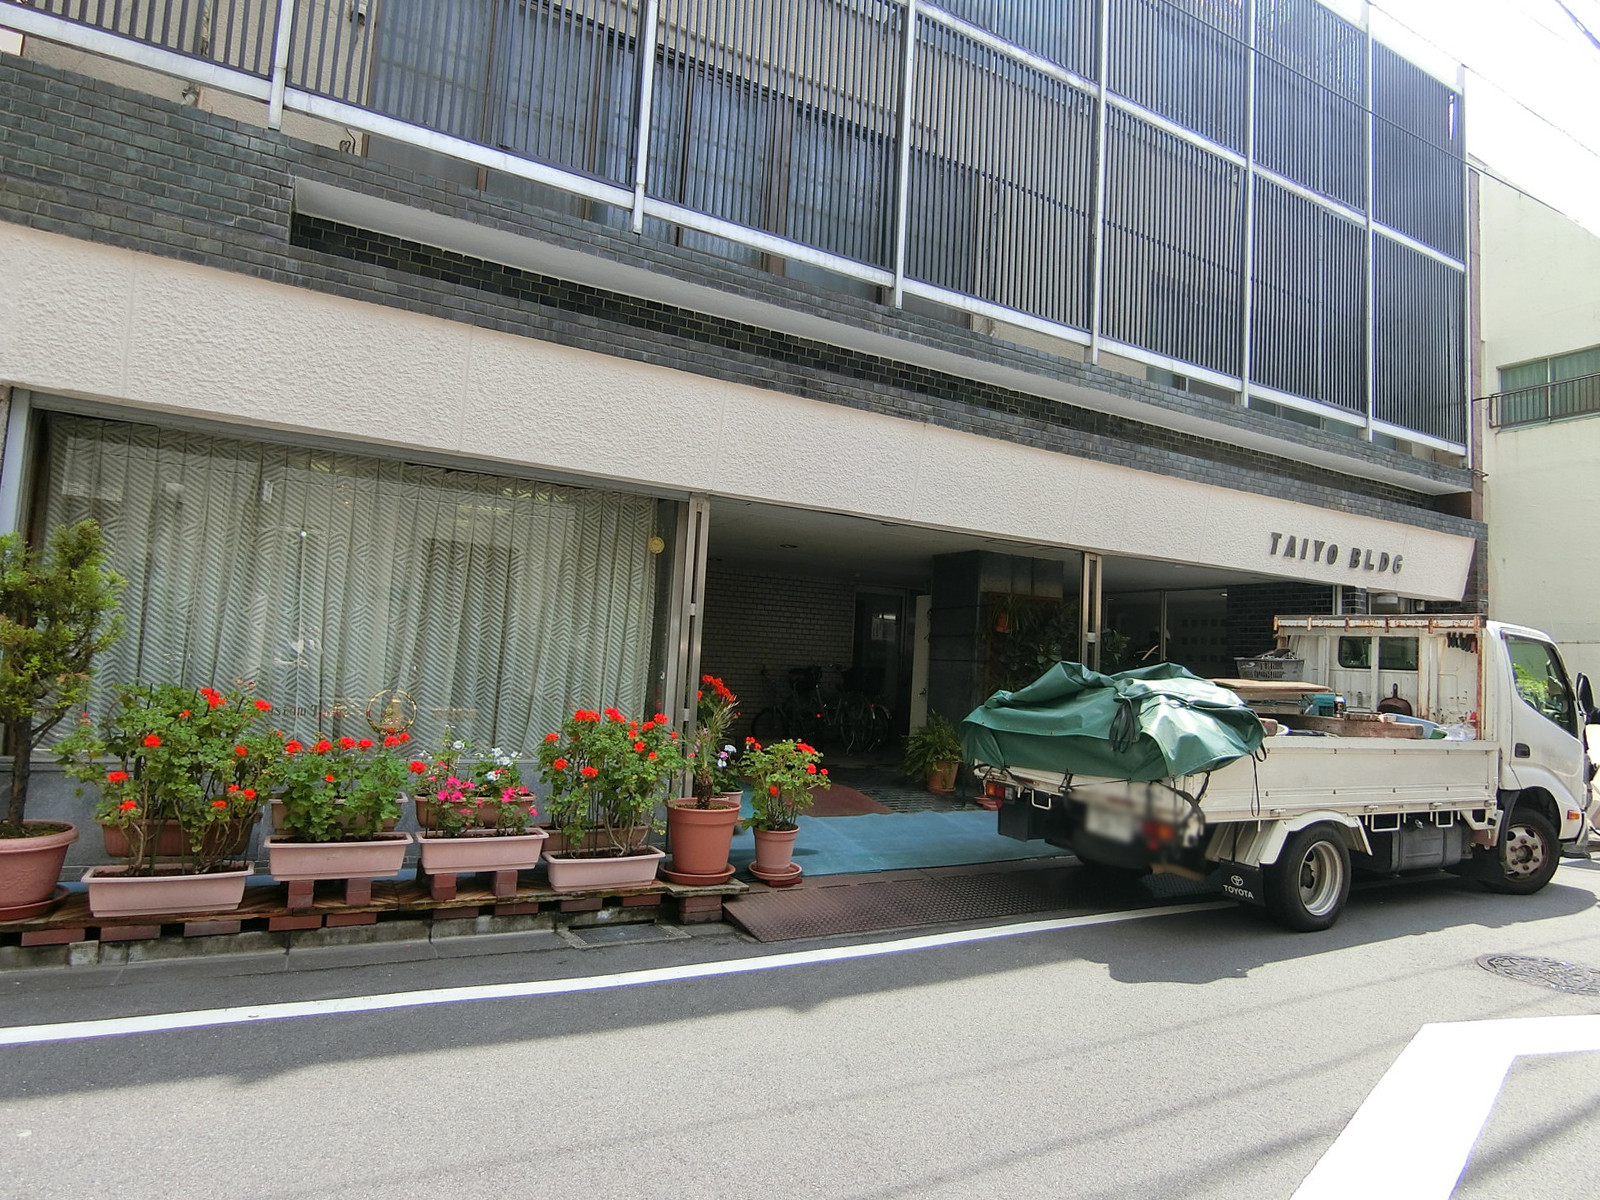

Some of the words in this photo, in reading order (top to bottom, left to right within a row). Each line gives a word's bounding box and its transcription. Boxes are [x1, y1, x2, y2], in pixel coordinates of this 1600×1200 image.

[1270, 532, 1339, 565] TAIYO
[1349, 547, 1404, 574] BLDG
[1223, 884, 1254, 899] TOYOTA
